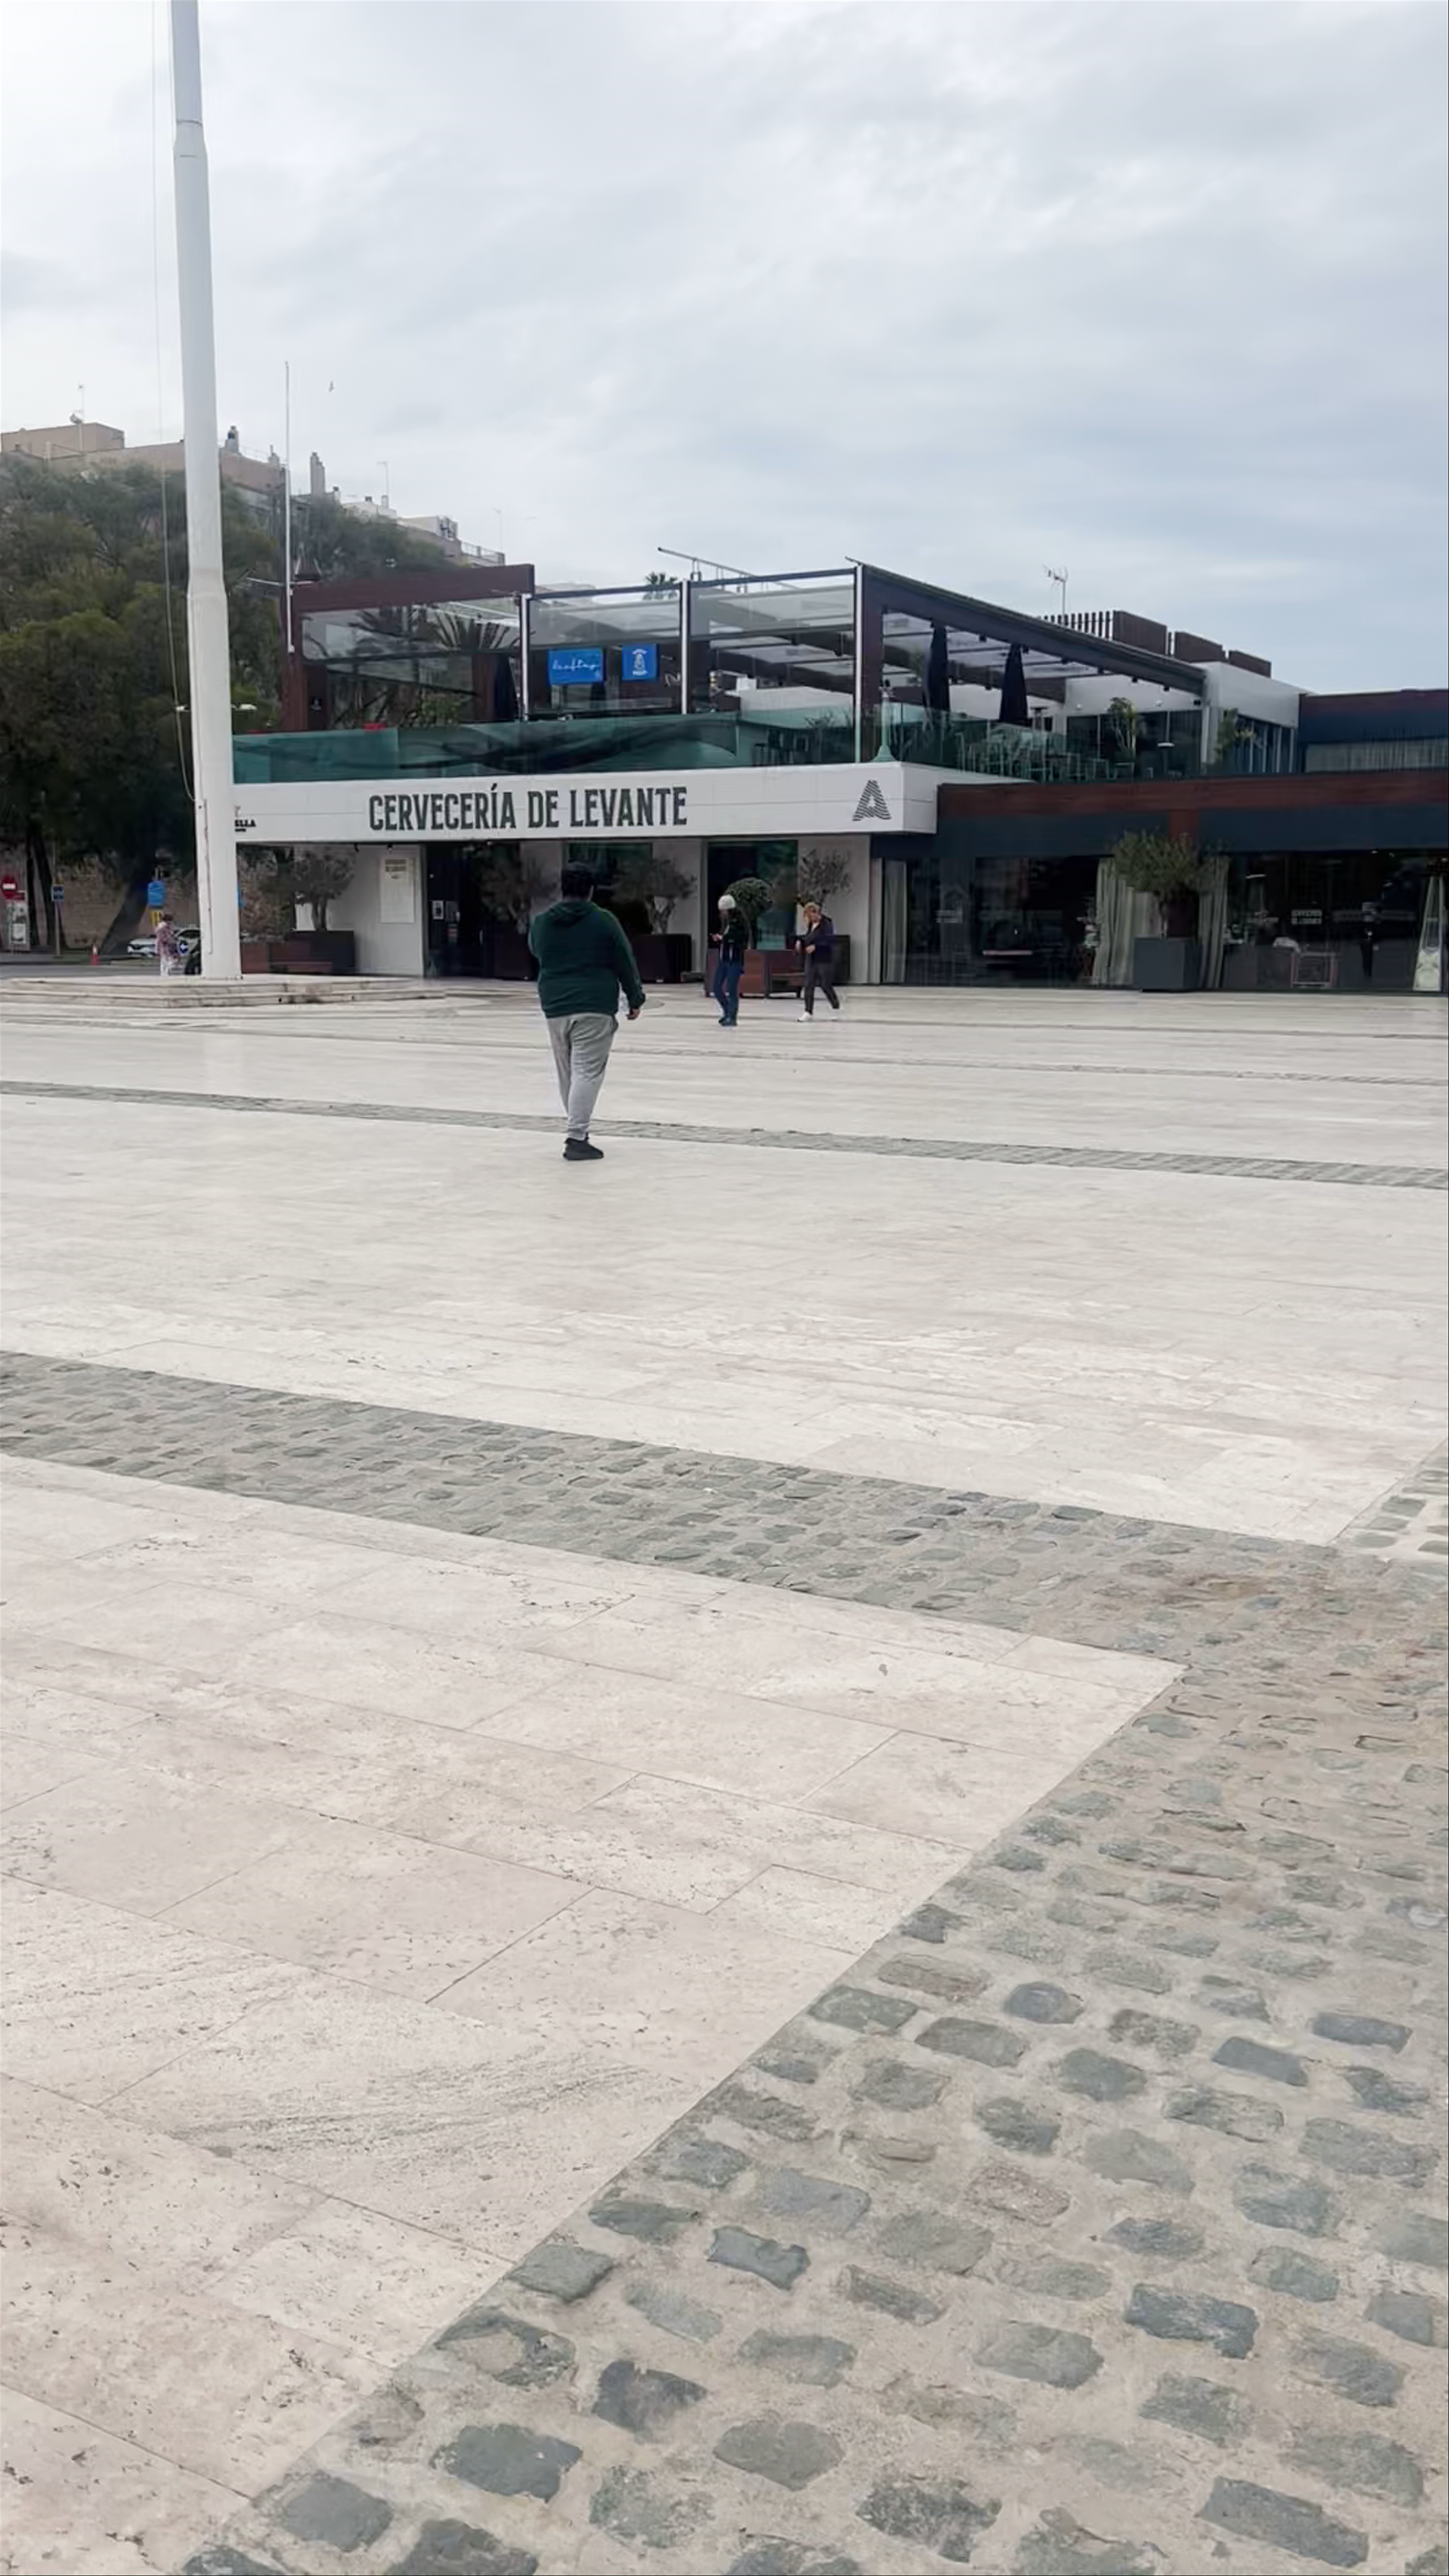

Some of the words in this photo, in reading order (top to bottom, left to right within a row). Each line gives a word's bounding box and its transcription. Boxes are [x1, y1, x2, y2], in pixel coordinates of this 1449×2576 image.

[369, 783, 517, 830] CERVECERÍA
[527, 790, 559, 828] DE
[569, 787, 687, 827] LEVANTE
[852, 780, 892, 821] A
